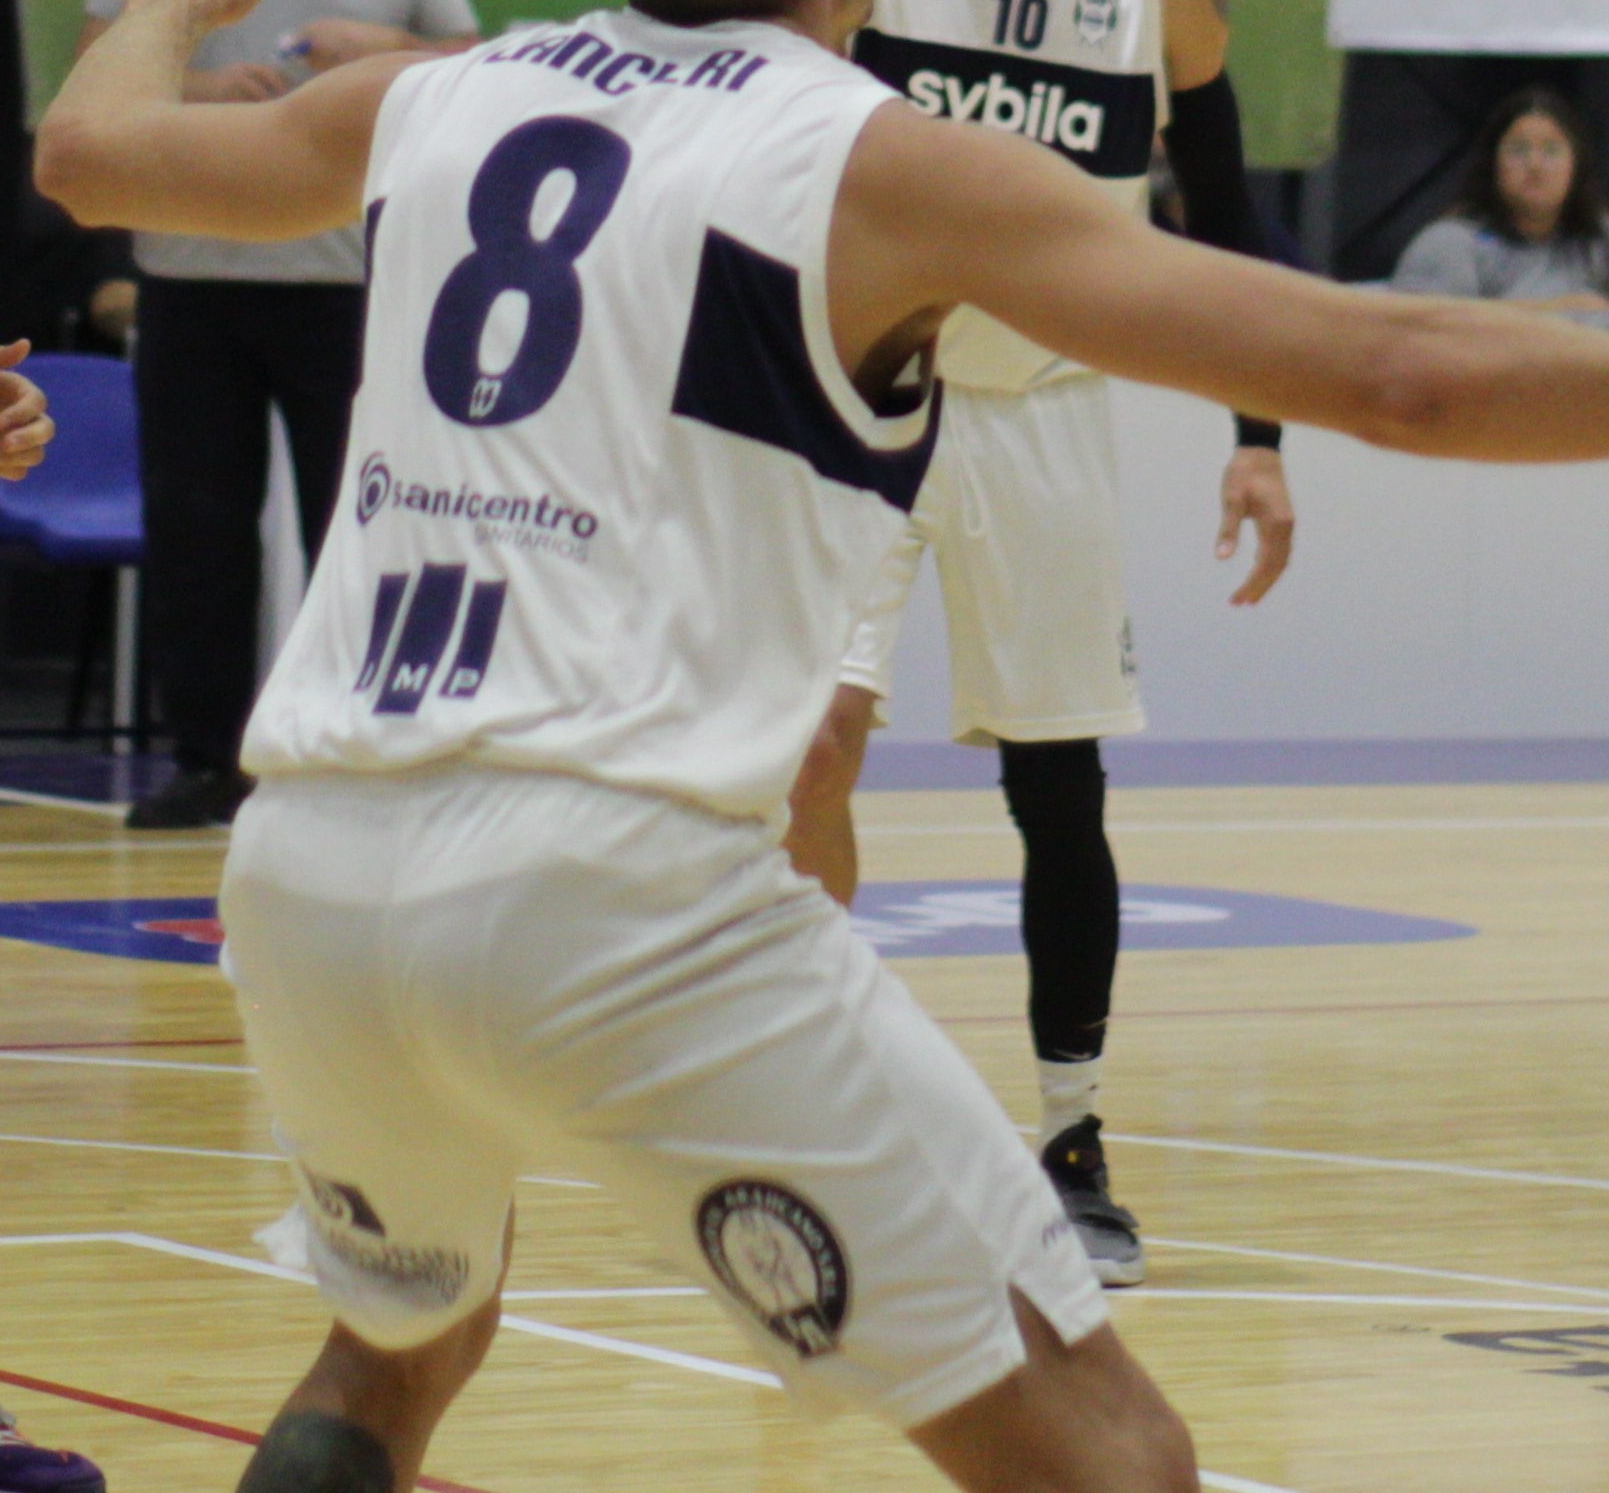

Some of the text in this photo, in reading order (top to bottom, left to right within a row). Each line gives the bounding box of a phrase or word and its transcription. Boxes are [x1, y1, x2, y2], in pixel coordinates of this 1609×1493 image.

[908, 68, 1105, 154] sybila
[424, 115, 633, 428] 8
[392, 481, 599, 540] sanicentro
